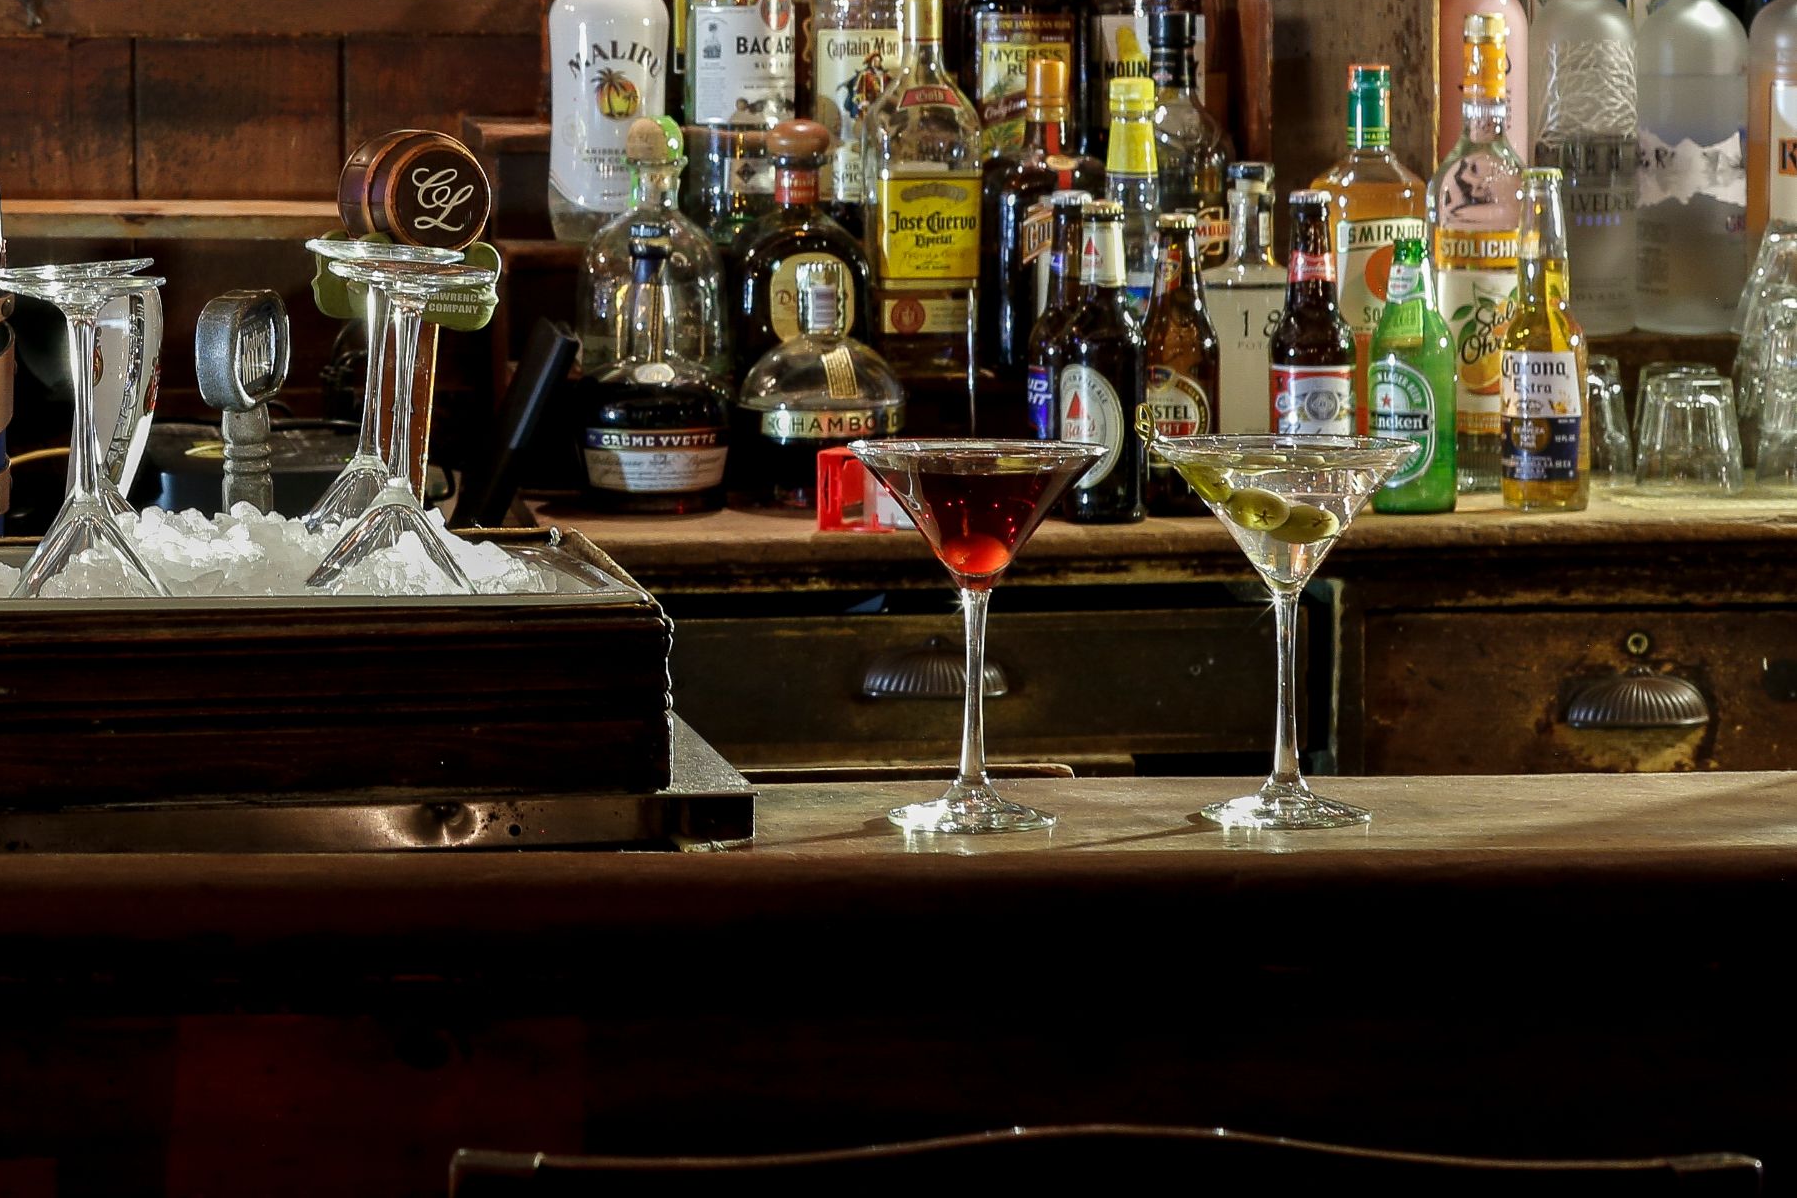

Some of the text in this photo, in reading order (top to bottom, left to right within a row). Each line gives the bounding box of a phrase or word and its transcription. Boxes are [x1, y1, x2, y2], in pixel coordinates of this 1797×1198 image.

[827, 37, 900, 61] Captain Mor
[988, 48, 1063, 61] MYERS'S
[568, 39, 663, 80] MALIBU
[1007, 63, 1027, 75] RU
[1105, 60, 1151, 78] MOUN
[833, 168, 863, 183] SPIC
[926, 209, 978, 234] Cuervo
[1441, 239, 1521, 258] STOLICHN
[428, 303, 479, 314] COMPANY
[1475, 301, 1516, 337] Stol
[1029, 379, 1048, 392] UD
[1514, 378, 1553, 394] Etra
[1153, 405, 1190, 419] STEL
[1378, 414, 1423, 430] neken
[659, 433, 717, 447] YVETTE
